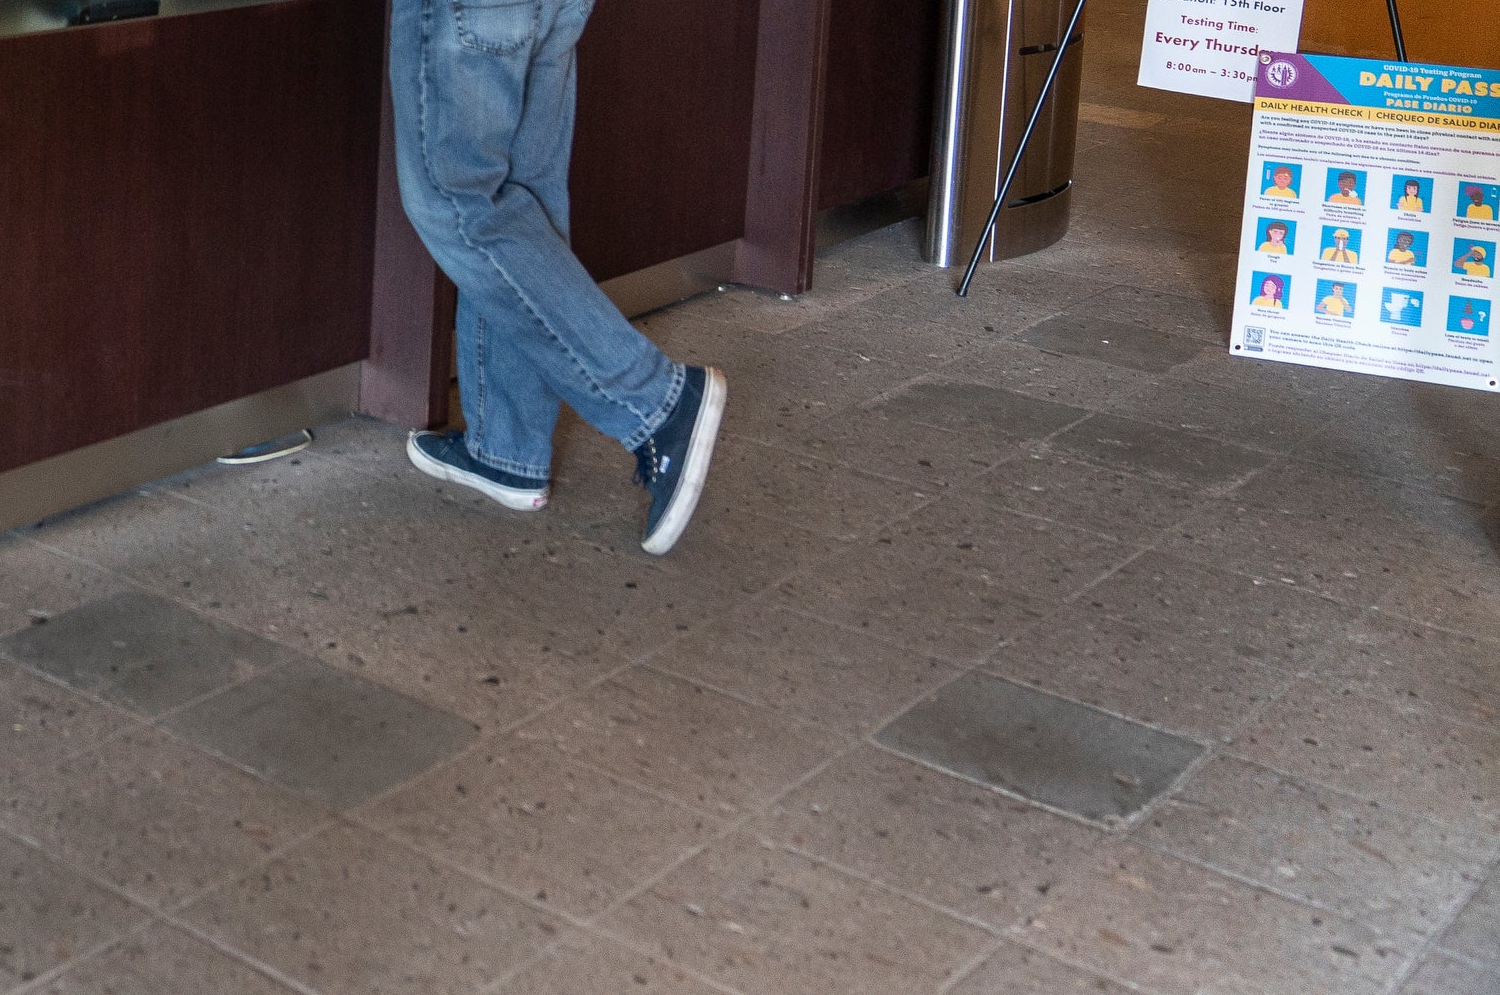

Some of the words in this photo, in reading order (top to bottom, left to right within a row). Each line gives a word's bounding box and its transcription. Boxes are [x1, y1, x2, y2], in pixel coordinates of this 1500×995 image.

[1254, 1, 1286, 13] Floor
[1181, 15, 1223, 31] Testing
[1228, 21, 1258, 33] Time:
[1156, 32, 1199, 51] Every
[1206, 38, 1280, 56] Thursd
[1166, 61, 1206, 75] 8:00am
[1383, 65, 1419, 73] COVID-19
[1420, 68, 1448, 77] Testing
[1449, 70, 1482, 78] Program
[1359, 71, 1432, 91] DAILY
[1441, 77, 1500, 98] PASS
[1261, 101, 1288, 110] DAILY
[1291, 104, 1328, 113] HEALTH
[1331, 108, 1362, 117] CHECK
[1386, 98, 1419, 109] PASE
[1423, 101, 1472, 113] DIARIO
[1376, 112, 1425, 123] CHEQUEO
[1443, 118, 1477, 128] SALUD
